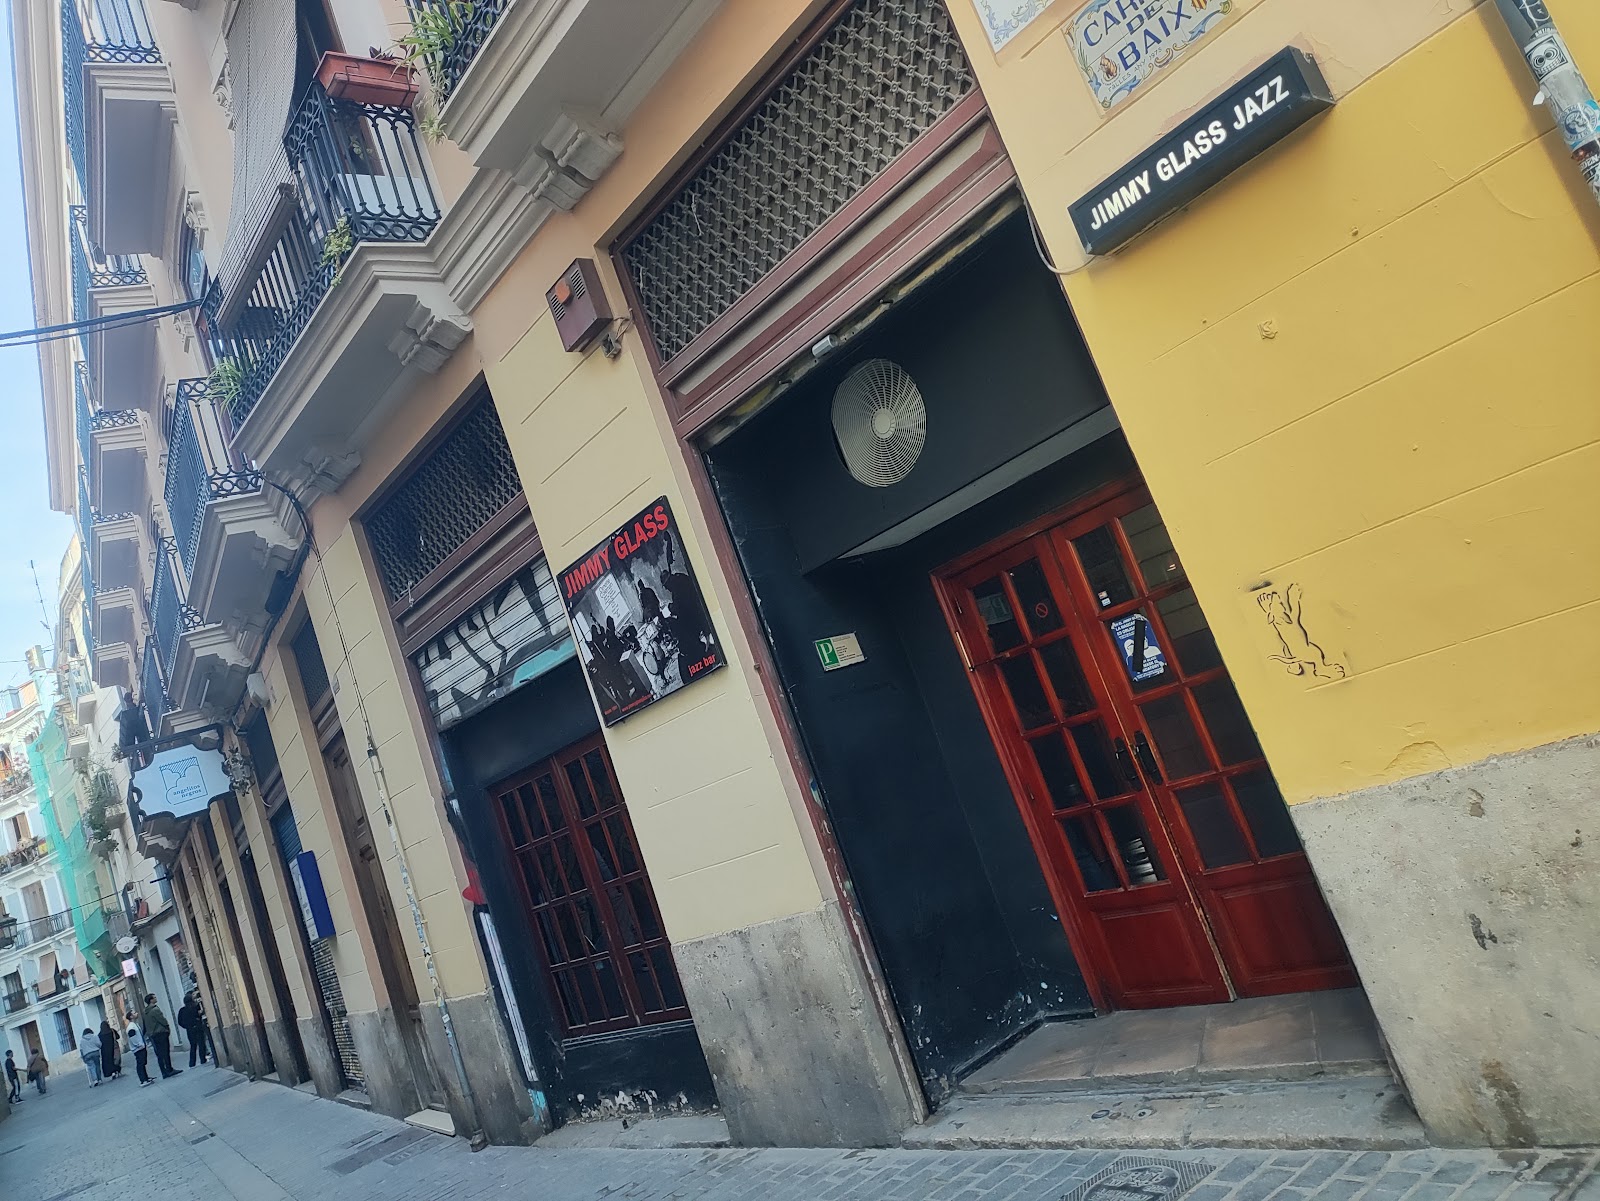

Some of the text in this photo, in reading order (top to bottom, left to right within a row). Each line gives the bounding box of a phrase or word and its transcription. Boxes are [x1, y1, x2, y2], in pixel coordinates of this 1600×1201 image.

[1126, 0, 1164, 36] DE
[1117, 0, 1192, 72] BAIX
[1090, 75, 1290, 232] JIMMY GLASS JAZZ
[563, 505, 669, 599] JIMMY GLASS
[688, 652, 716, 677] jazz bar
[819, 643, 833, 664] P
[173, 784, 201, 796] angelitos
[181, 789, 202, 798] negros
